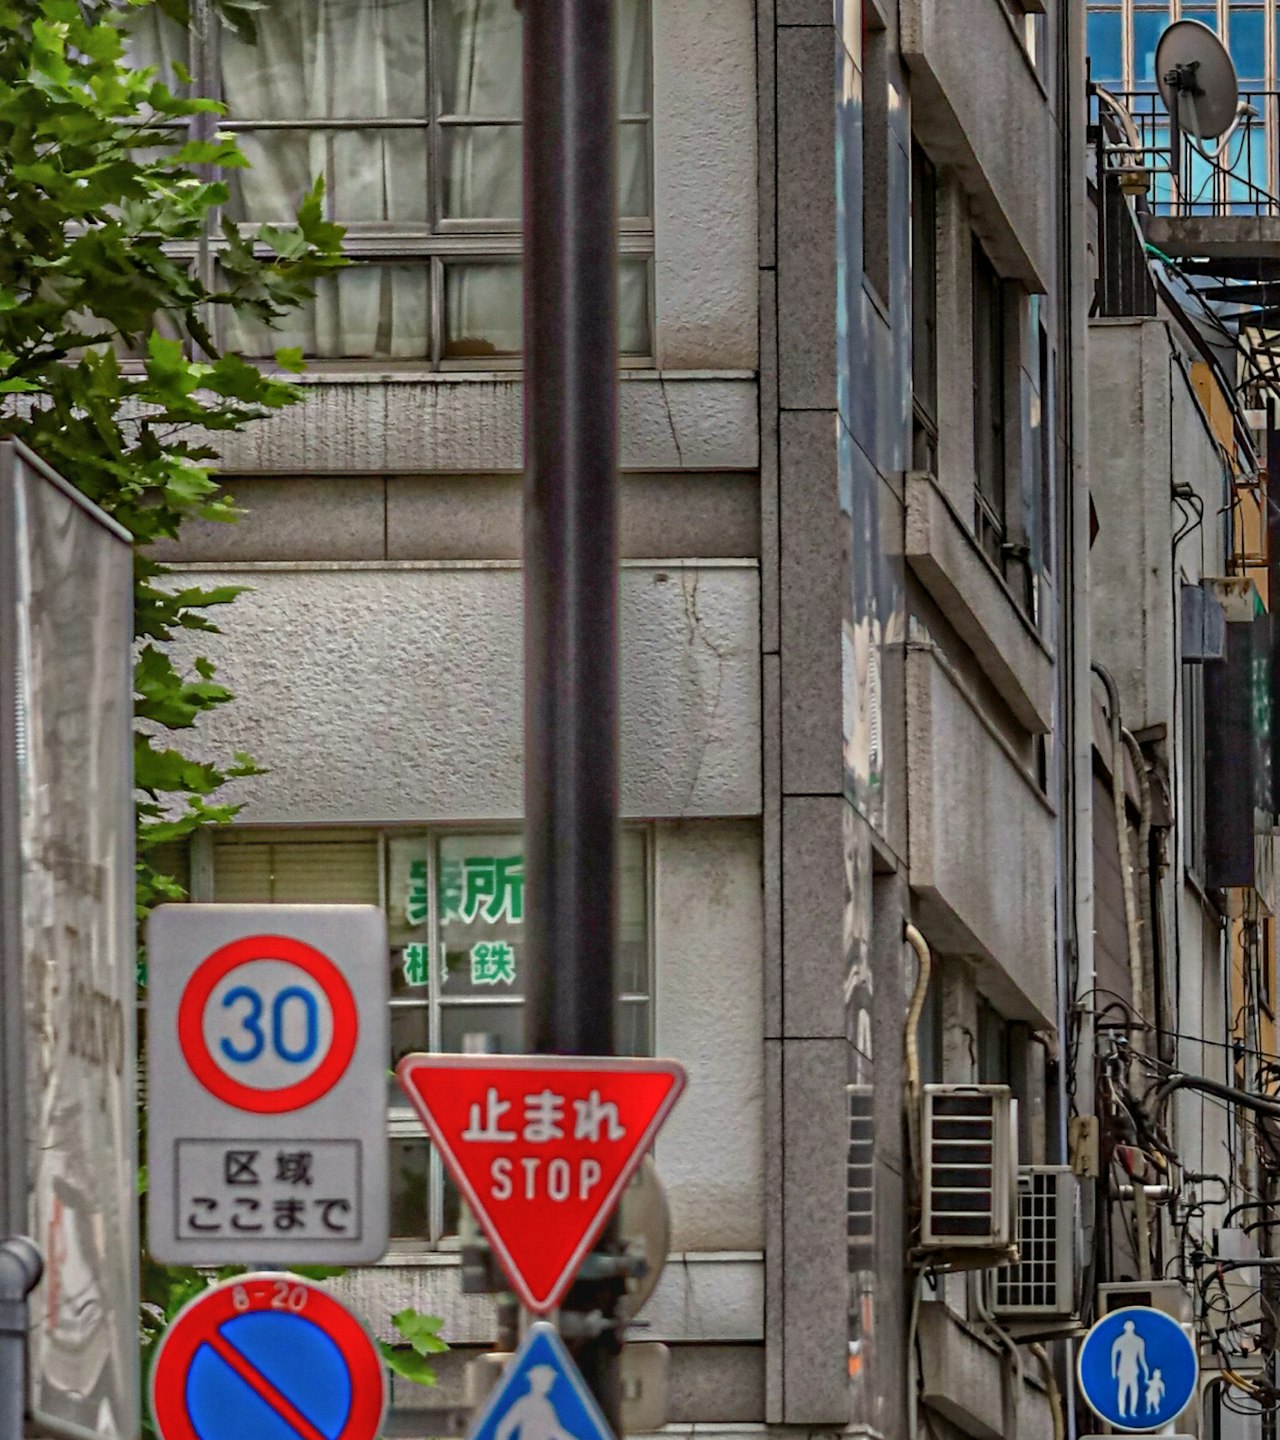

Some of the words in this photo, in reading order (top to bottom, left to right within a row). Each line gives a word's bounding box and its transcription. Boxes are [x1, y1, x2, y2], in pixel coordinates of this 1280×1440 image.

[219, 983, 319, 1064] 30
[462, 1089, 626, 1143] 止まれ
[225, 1152, 312, 1187] 区域
[491, 1157, 601, 1202] STOP
[187, 1196, 351, 1233] ここまで
[233, 1286, 308, 1311] 8-20
